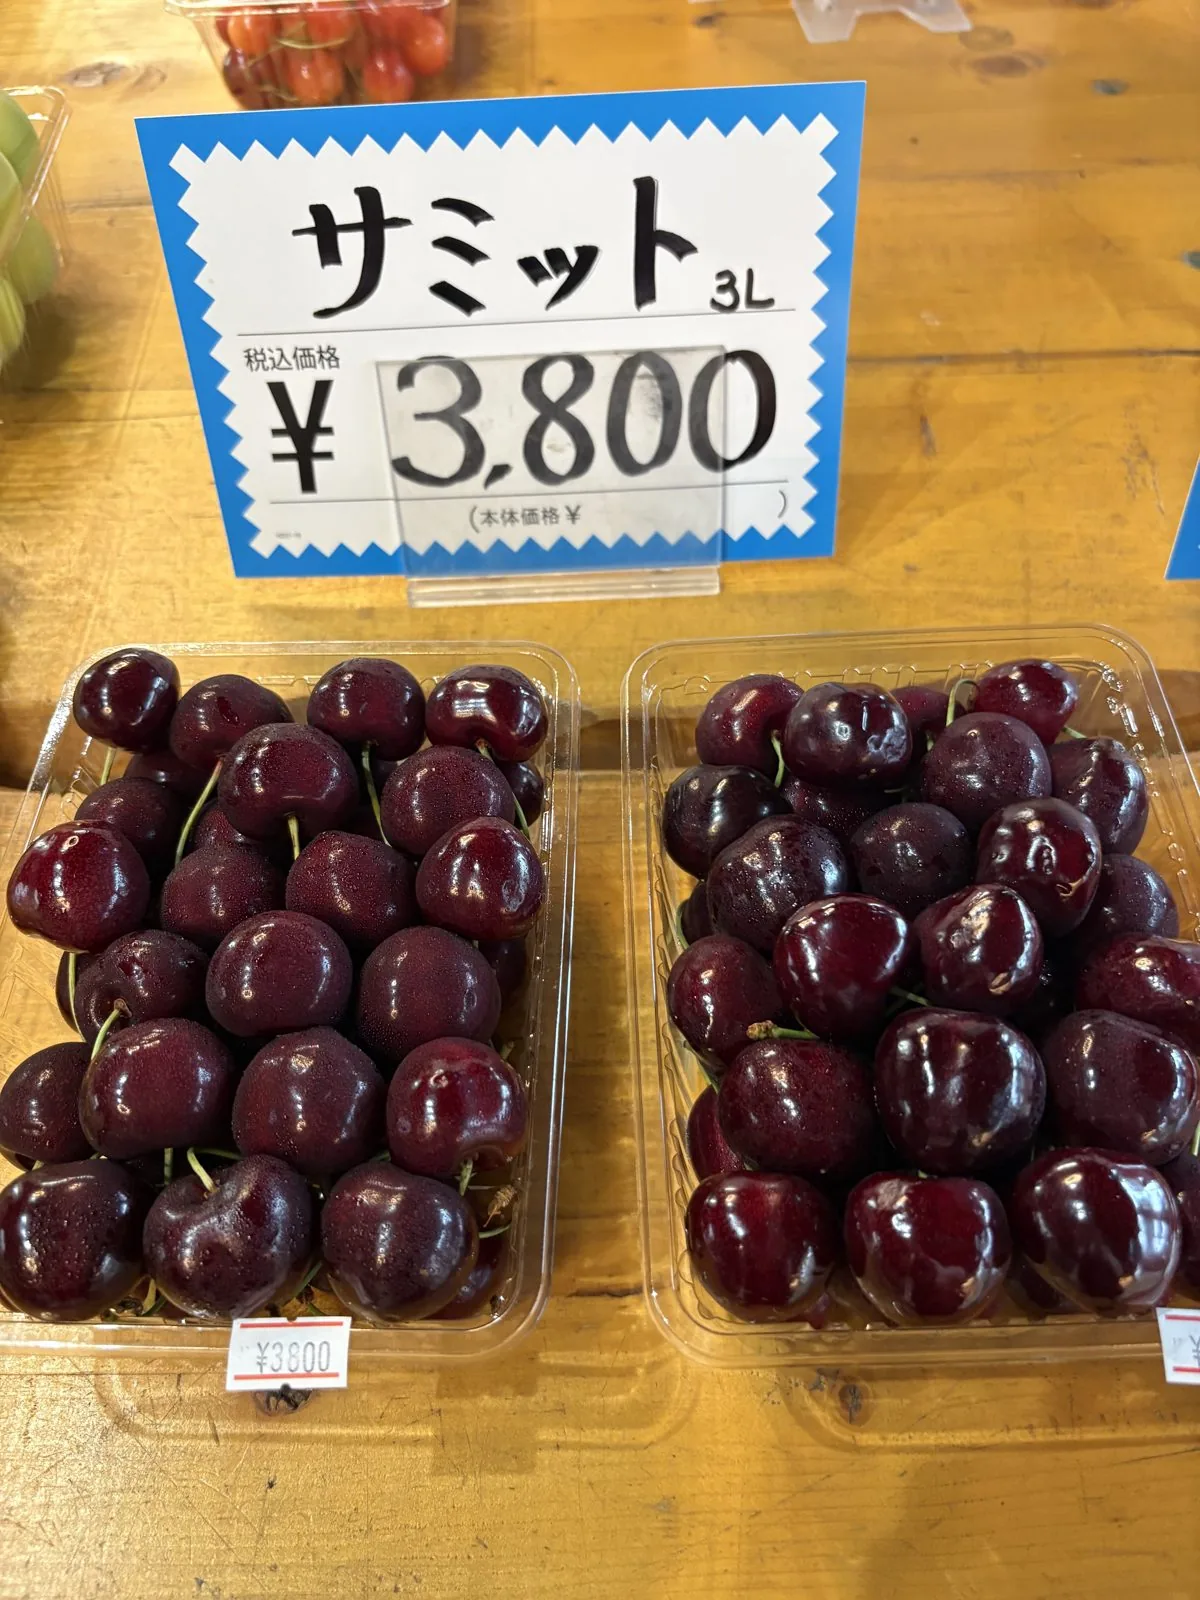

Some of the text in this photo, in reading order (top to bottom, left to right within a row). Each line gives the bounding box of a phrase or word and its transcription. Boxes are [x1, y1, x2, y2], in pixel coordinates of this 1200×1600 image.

[292, 176, 775, 318] サミット 3L
[243, 345, 341, 372] 税込価格
[391, 349, 778, 489] 3,800
[256, 1340, 331, 1374] ¥3800
